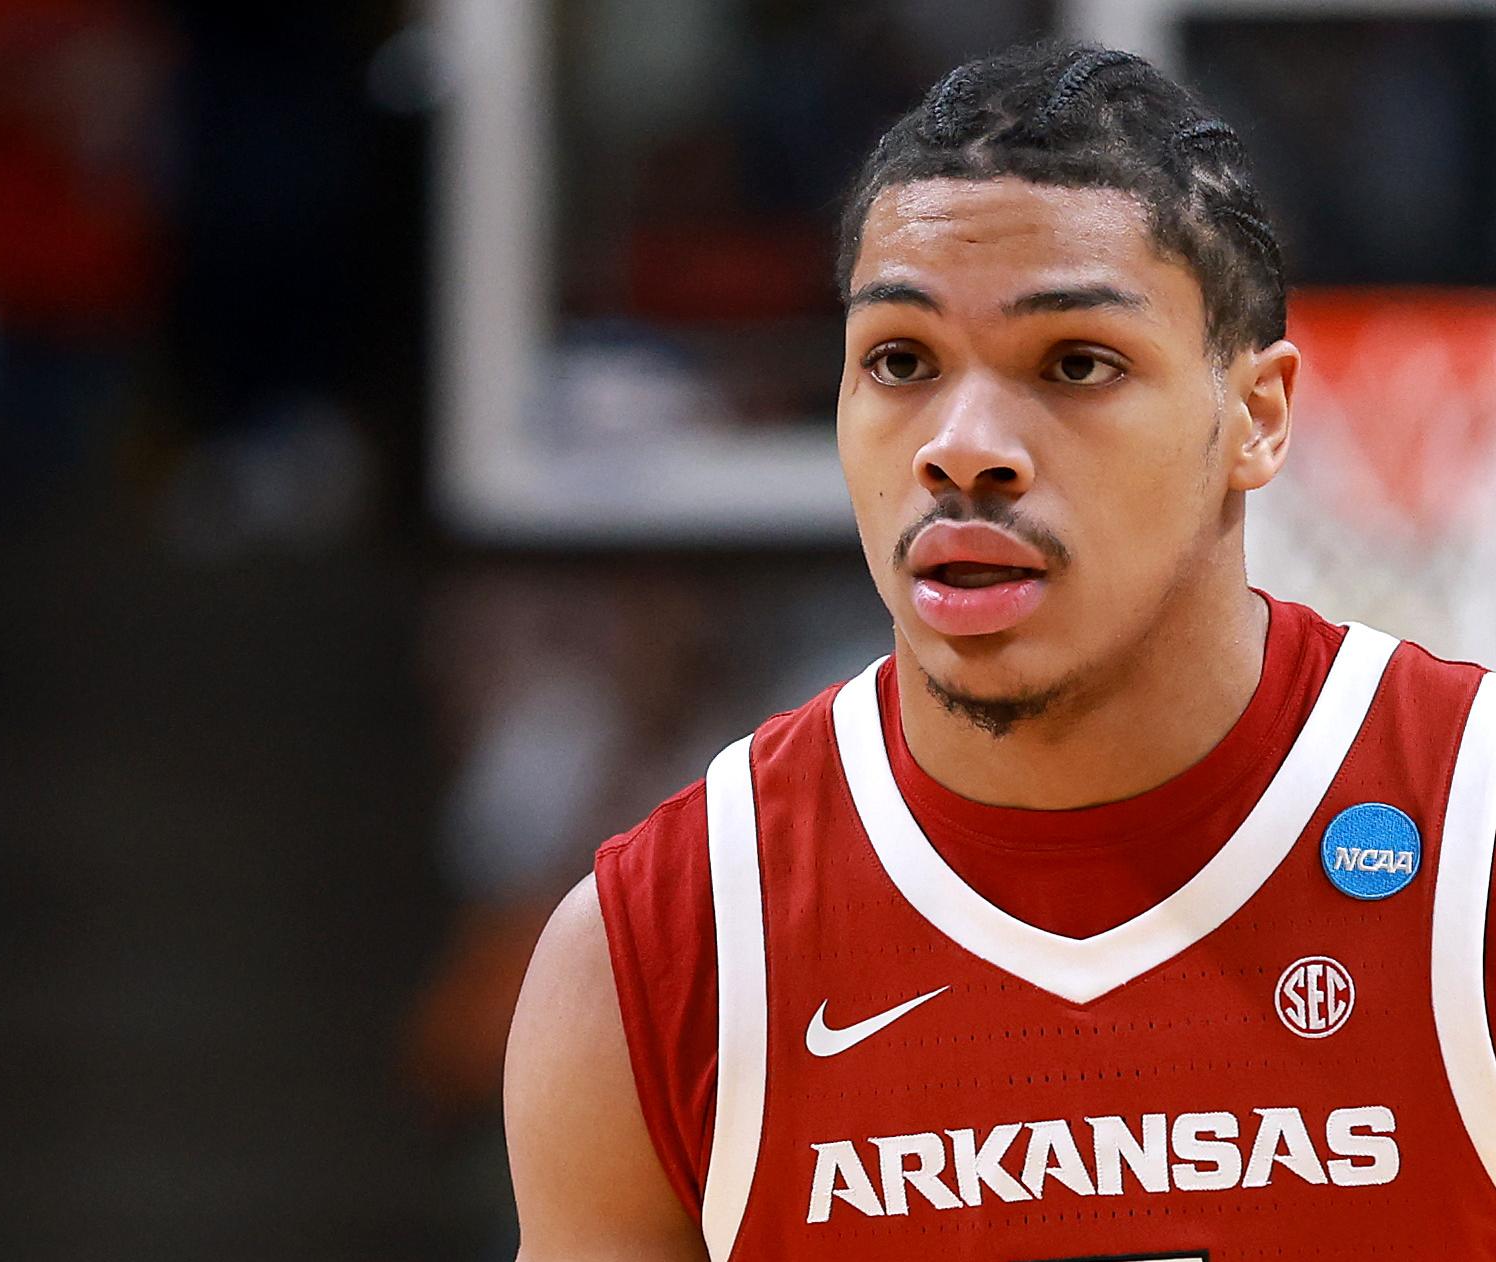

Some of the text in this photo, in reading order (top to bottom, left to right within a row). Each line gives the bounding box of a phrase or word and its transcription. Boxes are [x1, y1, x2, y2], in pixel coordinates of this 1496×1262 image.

[1333, 847, 1414, 874] NCAA
[1283, 963, 1348, 1030] SEC
[806, 1105, 1401, 1224] ARKANSAS
